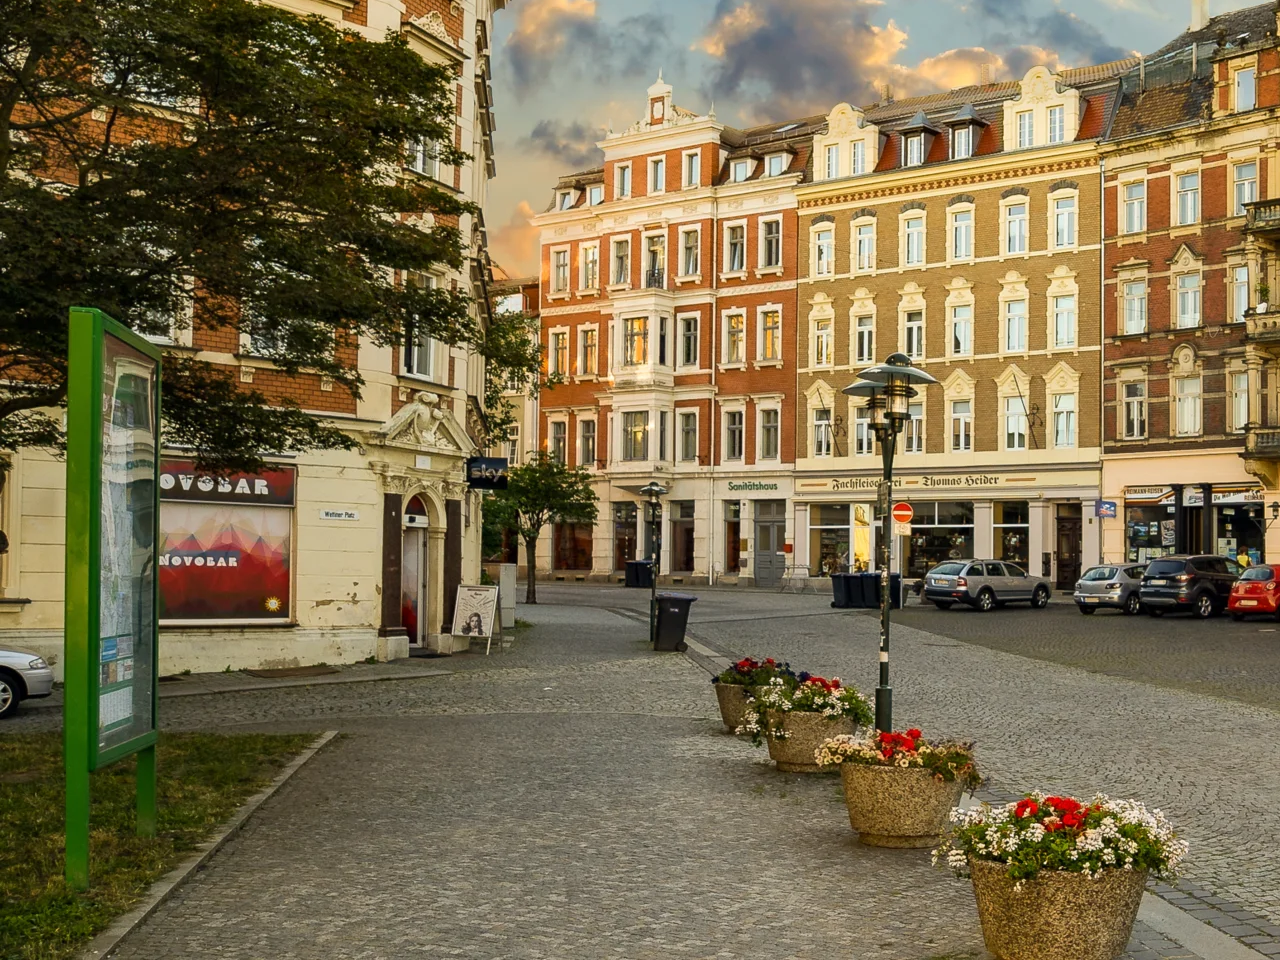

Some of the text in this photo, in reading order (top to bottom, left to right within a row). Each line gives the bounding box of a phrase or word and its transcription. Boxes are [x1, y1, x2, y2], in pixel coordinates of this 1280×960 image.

[471, 464, 504, 482] sky
[159, 473, 269, 495] OVOBAR
[728, 481, 778, 491] Sanitätshaus
[832, 475, 999, 491] Fachfleiscei Thomas Heider
[344, 511, 356, 519] Platz
[159, 554, 238, 567] NOVOBAR
